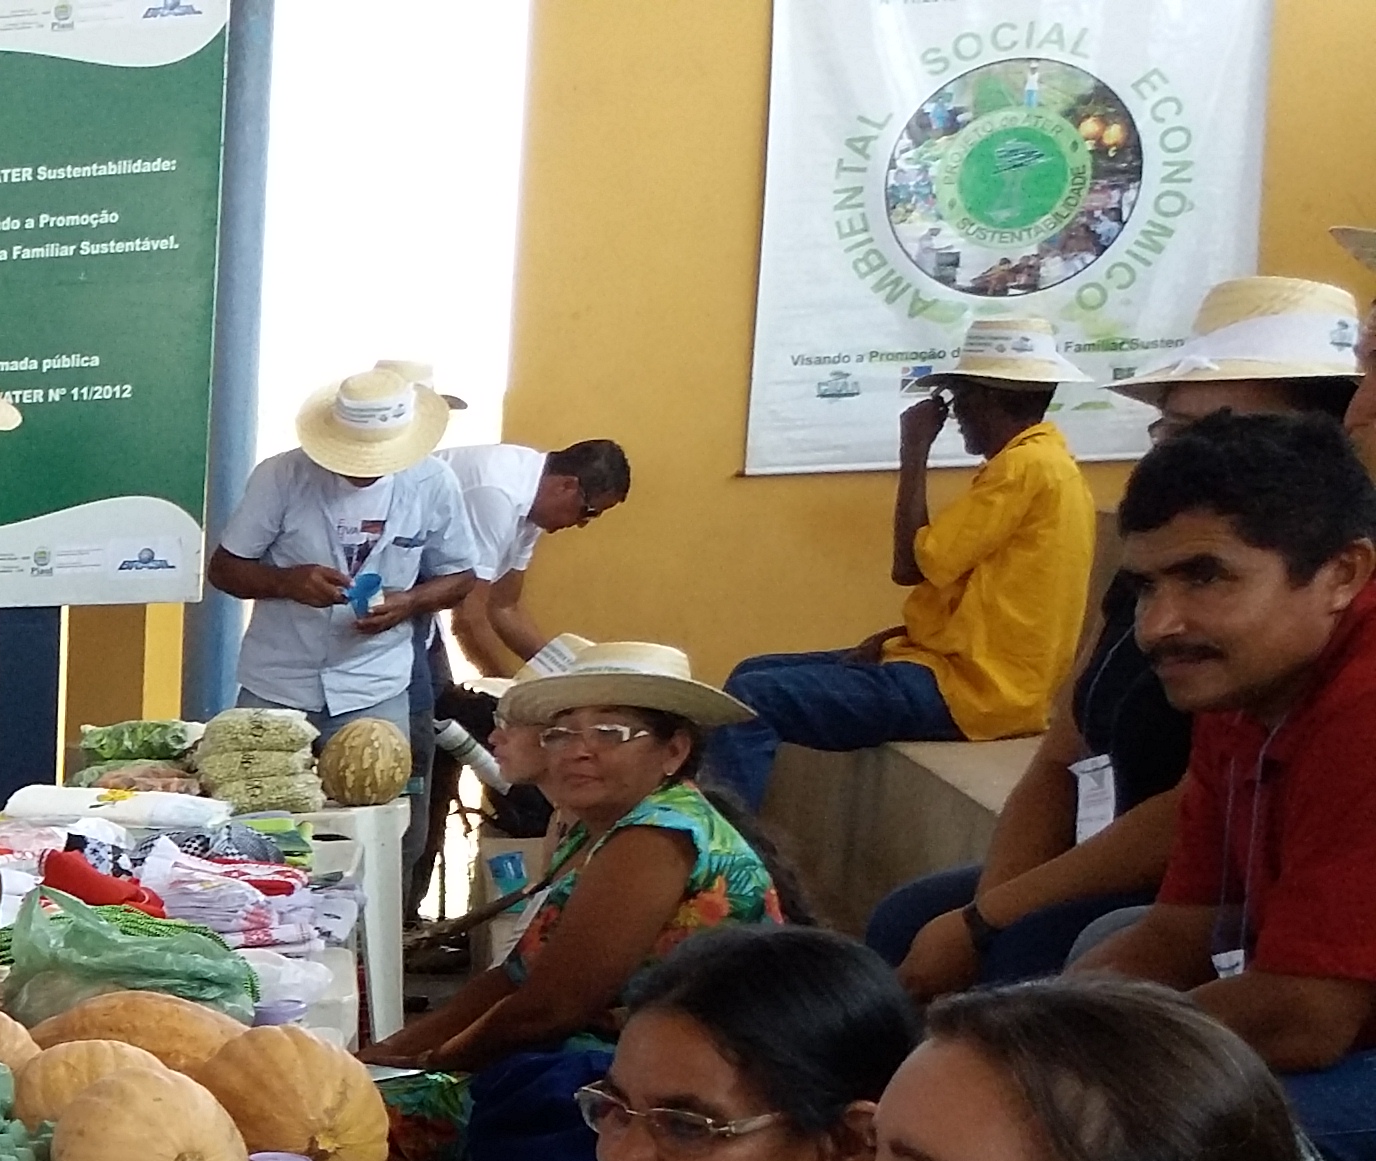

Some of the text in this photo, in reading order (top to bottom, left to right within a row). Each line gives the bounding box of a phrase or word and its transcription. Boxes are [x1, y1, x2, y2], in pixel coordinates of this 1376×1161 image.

[920, 20, 1090, 76] SOCIAL
[37, 157, 177, 181] Sustentabilidade:
[1076, 67, 1195, 312] ECONÔMICO
[833, 112, 939, 319] AMBIENTAL
[956, 164, 1087, 244] SUSTENTABILIDADE
[25, 219, 34, 229] a
[39, 209, 119, 228] Promoção
[12, 242, 77, 260] Familiar
[80, 235, 180, 256] Sustentável.
[1064, 335, 1186, 353] Familiar Susten
[42, 353, 100, 373] pública
[791, 352, 851, 366] Visando
[855, 353, 864, 363] a
[868, 348, 946, 363] Promoção
[71, 384, 132, 401] 11/2012
